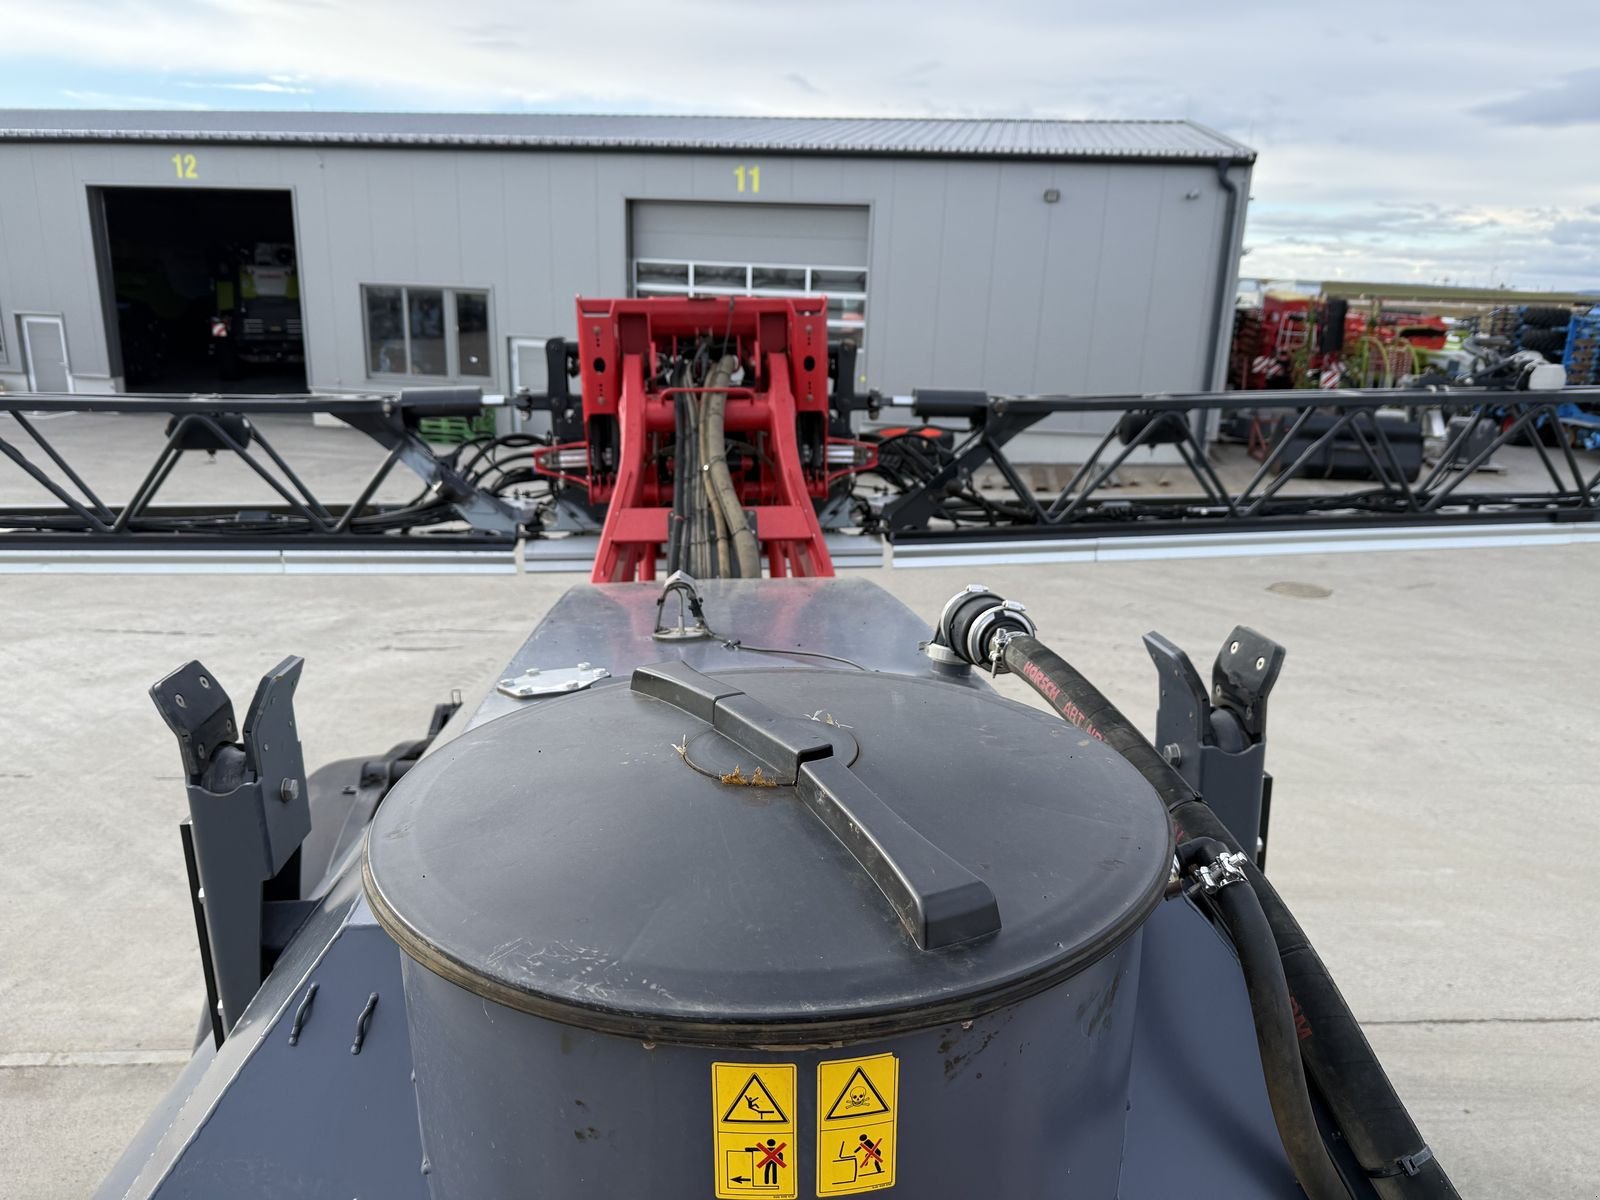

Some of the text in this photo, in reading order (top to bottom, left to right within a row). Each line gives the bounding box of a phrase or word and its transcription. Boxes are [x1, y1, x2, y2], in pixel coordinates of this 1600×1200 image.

[171, 153, 198, 178] 12
[733, 165, 760, 193] 11
[1023, 661, 1061, 701] HORSCH
